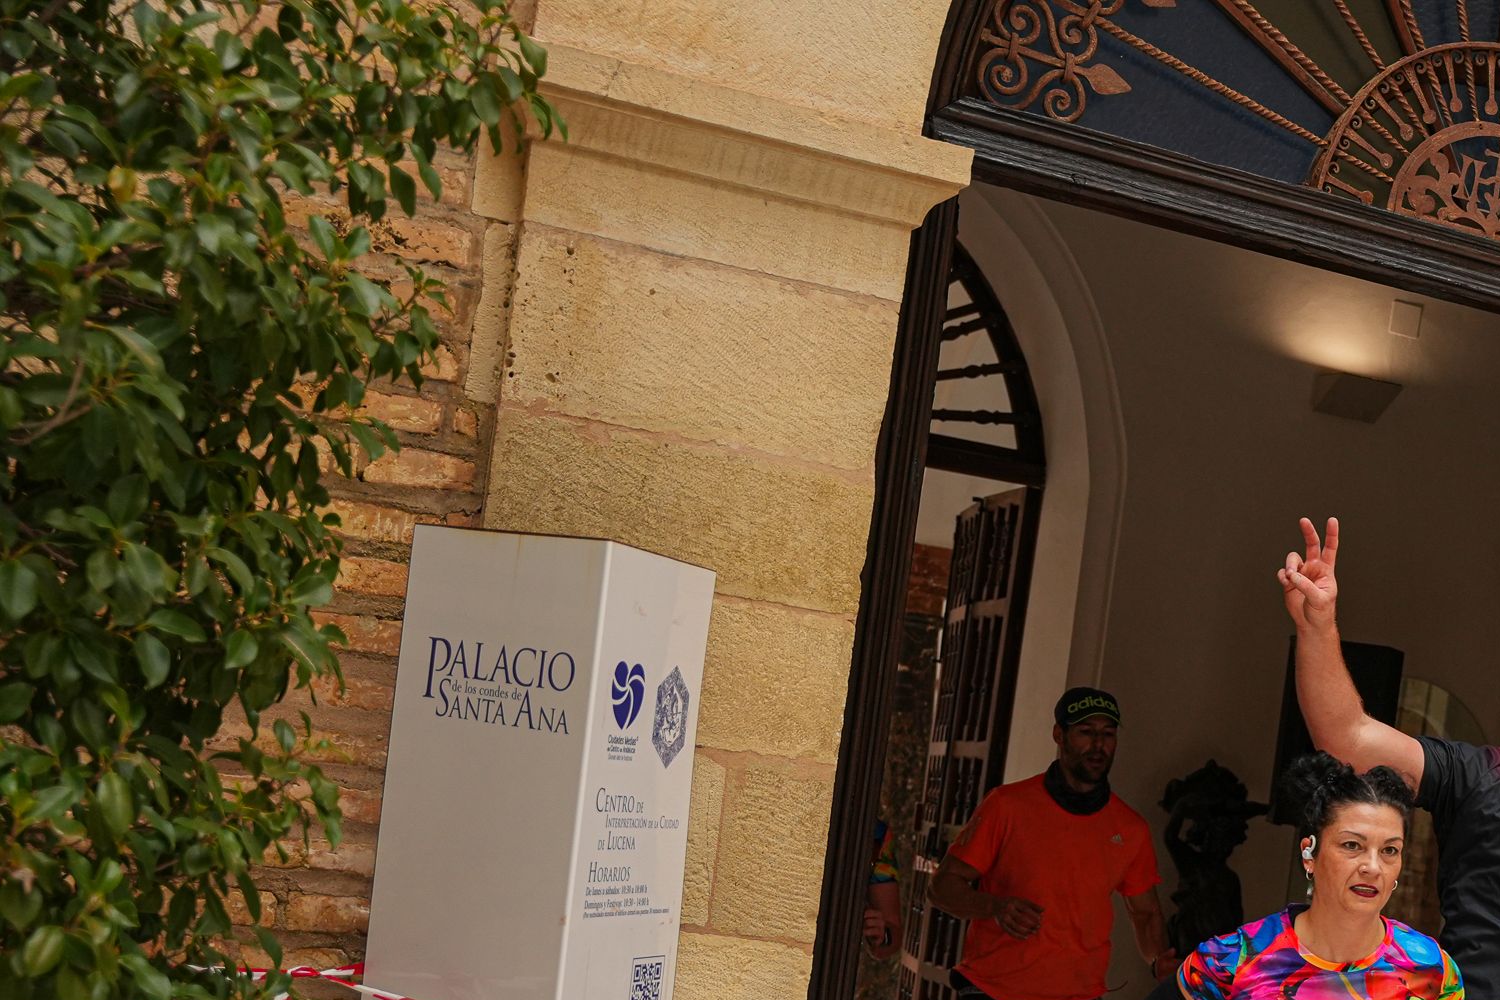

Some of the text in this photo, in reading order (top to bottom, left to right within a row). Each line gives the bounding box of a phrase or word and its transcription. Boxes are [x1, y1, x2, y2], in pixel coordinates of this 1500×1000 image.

[422, 636, 575, 698] PALACIO
[451, 679, 522, 700] de los condes de
[435, 678, 569, 735] SANTA ANA
[596, 787, 635, 813] CENTRO
[607, 831, 636, 850] LUCENA
[588, 861, 631, 883] HORARIOS
